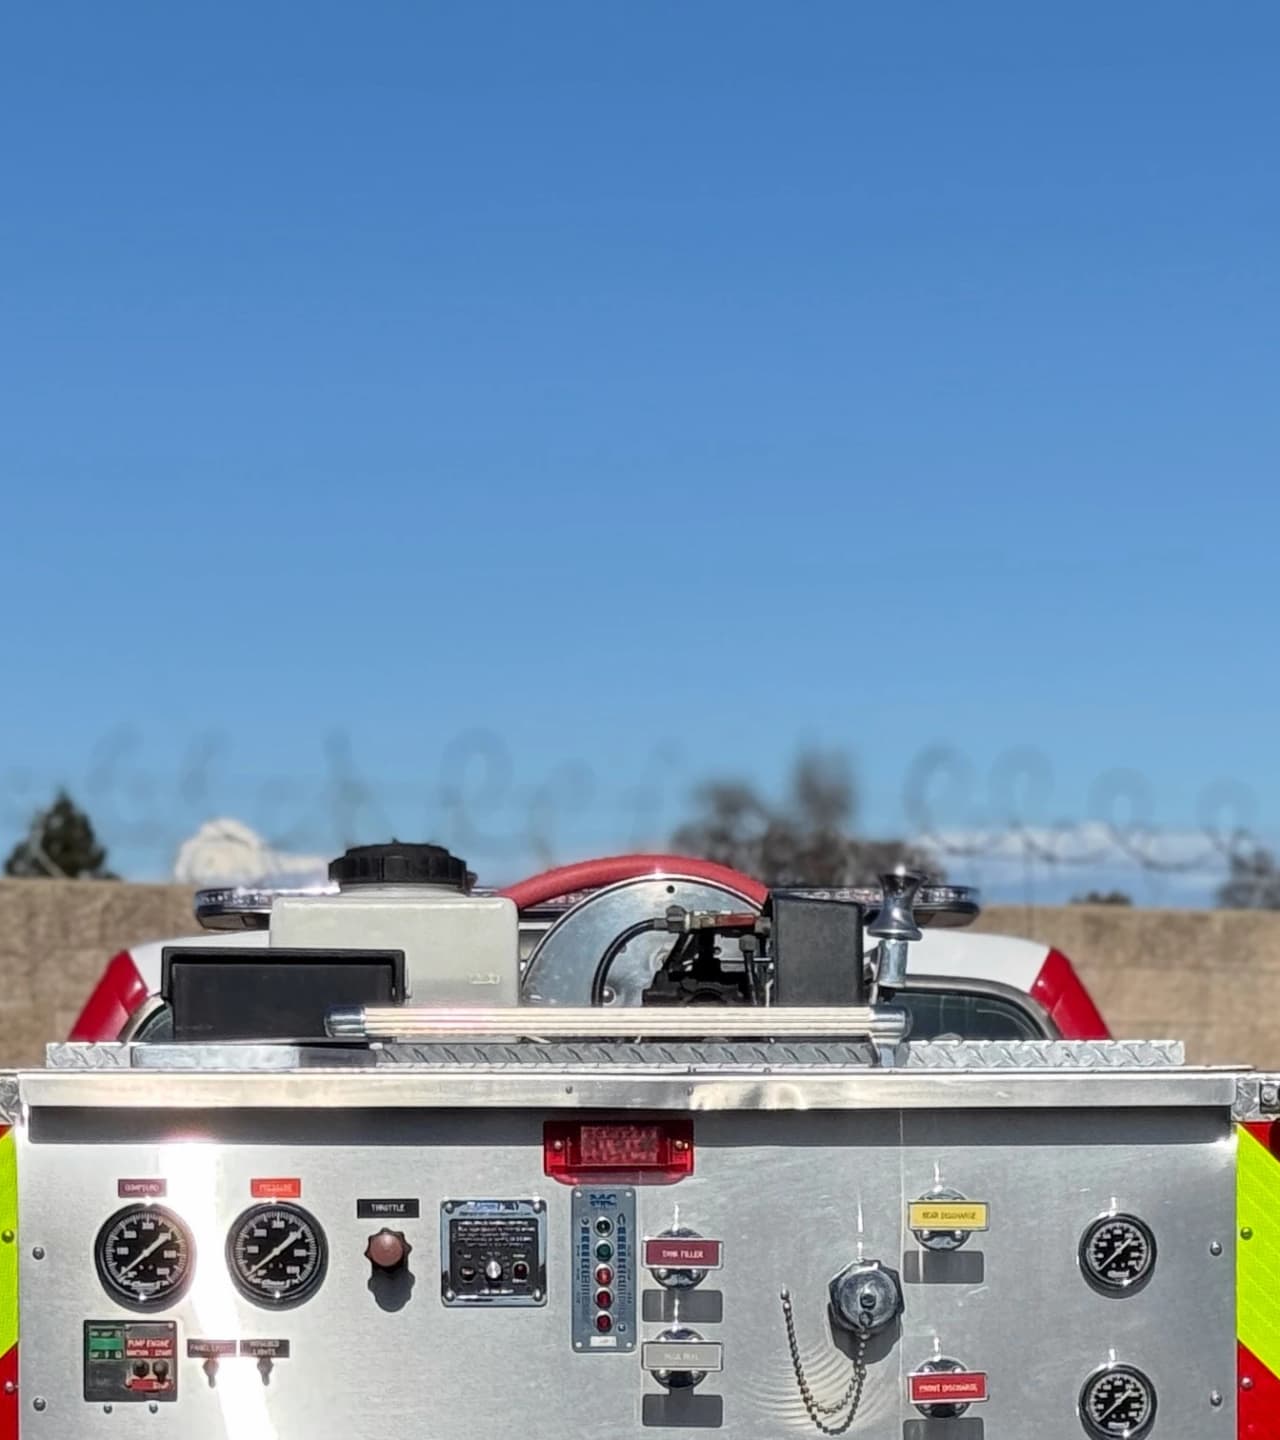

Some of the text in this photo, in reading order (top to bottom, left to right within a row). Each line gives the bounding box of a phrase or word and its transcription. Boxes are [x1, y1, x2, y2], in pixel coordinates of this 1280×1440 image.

[371, 1203, 406, 1213] THROTTLE
[680, 1250, 704, 1259] FILLER
[127, 1339, 170, 1348] PUMP ENGINE
